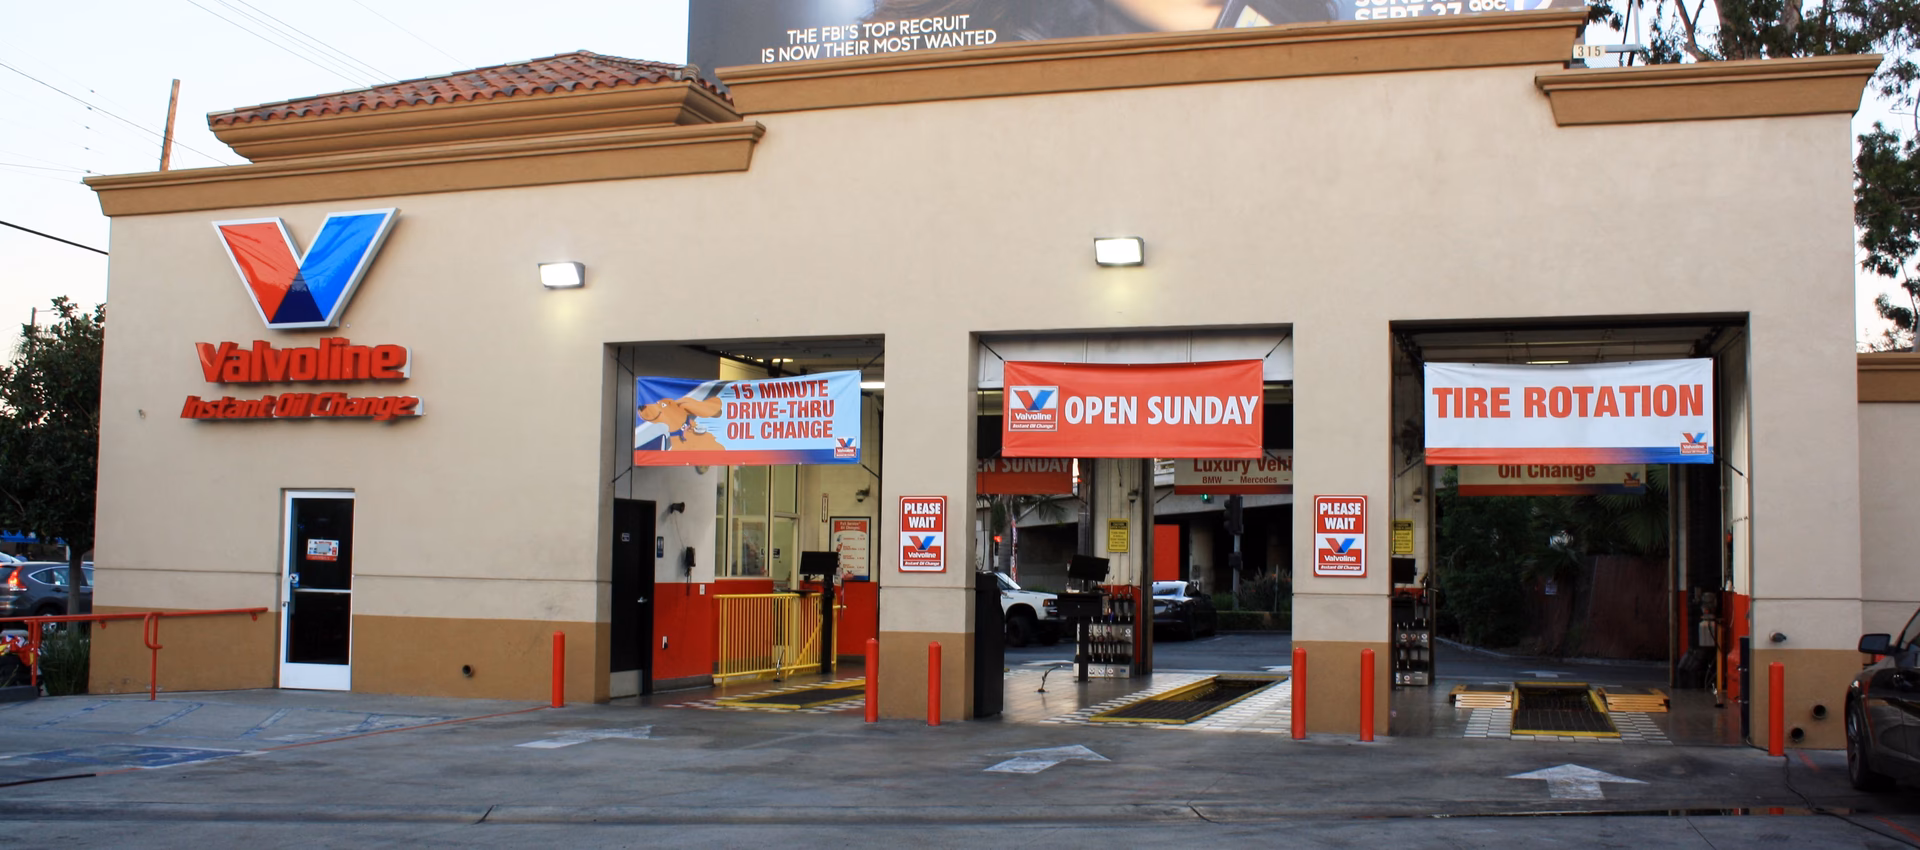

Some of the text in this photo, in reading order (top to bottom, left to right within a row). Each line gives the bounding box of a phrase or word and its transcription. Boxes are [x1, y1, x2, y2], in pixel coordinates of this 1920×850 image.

[1355, 4, 1424, 20] SEPT
[787, 14, 970, 45] THE FBI'S TOP RECRUIT
[761, 29, 997, 63] IS NOW THEIR MOST WANTED
[1578, 46, 1601, 57] 315
[195, 337, 409, 382] Valvoline
[731, 379, 829, 400] 15 MINUTE
[180, 392, 420, 422] Instant Oil Change
[727, 400, 835, 420] DRIVE-THRU
[1432, 384, 1704, 418] TIRE ROTATION
[1015, 412, 1052, 421] Valvoline
[1064, 396, 1259, 425] OPEN SUNDAY
[727, 420, 833, 440] OIL CHANGE
[1001, 458, 1070, 473] SUNDAY
[1193, 457, 1251, 475] Luxury
[1498, 464, 1596, 482] Oil Change
[1202, 475, 1277, 484] BMW Mercedes
[904, 502, 941, 515] PLEASE
[1319, 502, 1361, 515] PLEASE
[908, 516, 936, 529] WAIT
[1324, 517, 1356, 530] WAIT
